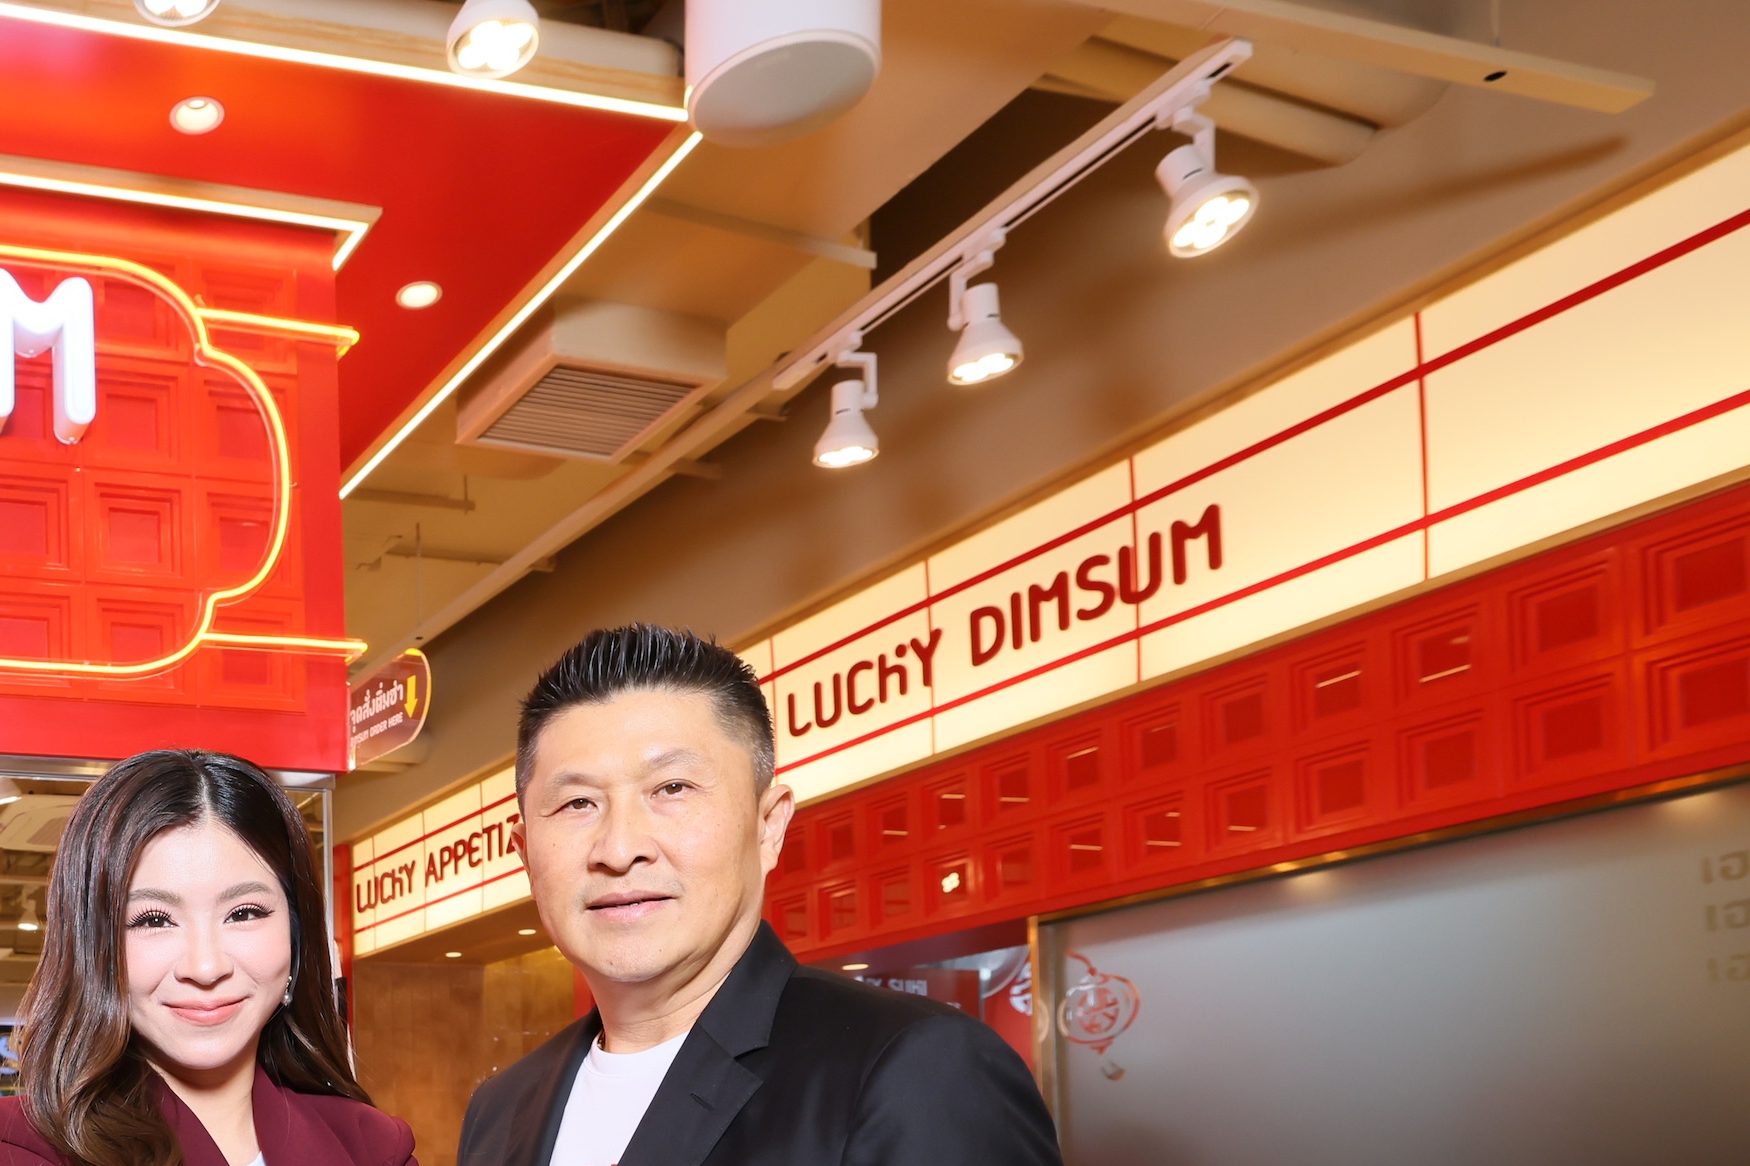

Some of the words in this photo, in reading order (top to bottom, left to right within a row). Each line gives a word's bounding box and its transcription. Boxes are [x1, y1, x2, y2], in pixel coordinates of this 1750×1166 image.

[969, 503, 1223, 667] DIMSUM
[369, 719, 388, 738] ORDER
[388, 711, 404, 728] HERE
[424, 812, 521, 888] APPETIZ
